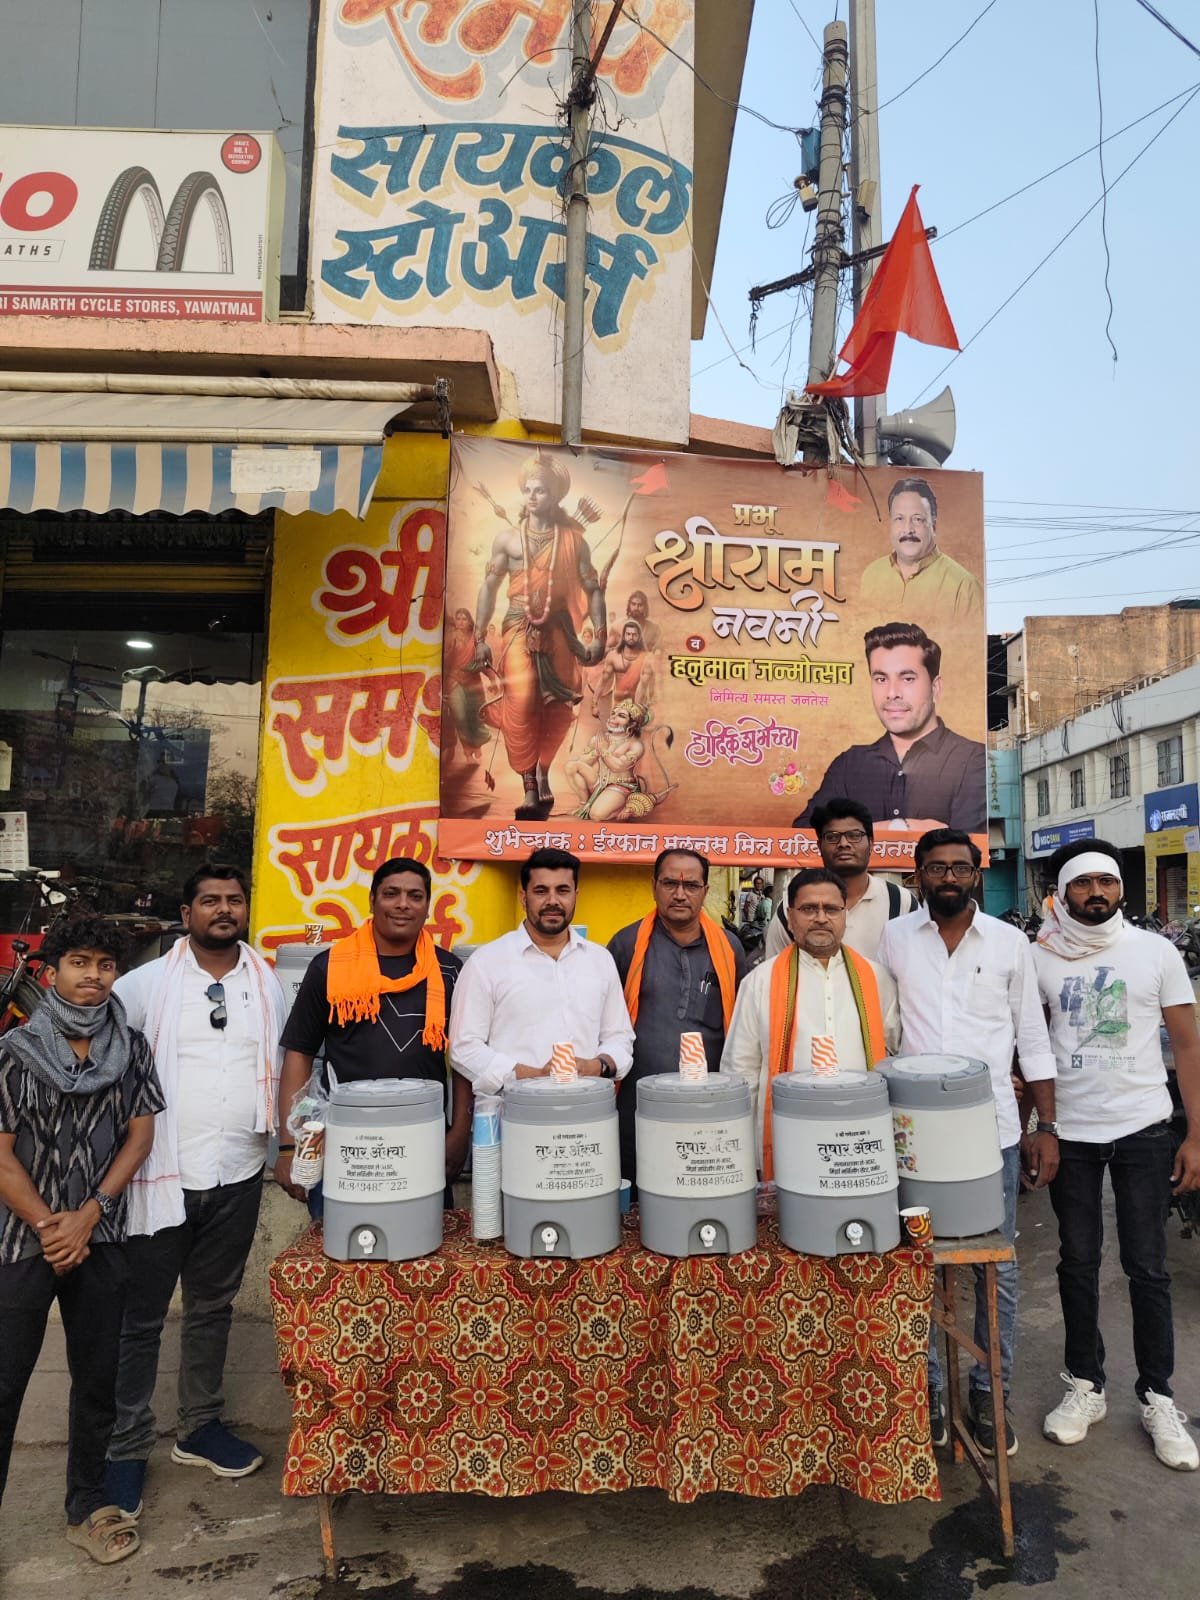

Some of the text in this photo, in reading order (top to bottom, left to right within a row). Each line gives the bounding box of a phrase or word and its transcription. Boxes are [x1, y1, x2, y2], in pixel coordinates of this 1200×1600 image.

[12, 296, 76, 311] SAMARTH
[80, 298, 121, 313] CYCLE
[126, 299, 180, 315] STORES,
[184, 301, 256, 316] YAWATMAL
[669, 653, 854, 687] हनुमान जन्मोत्सव
[753, 692, 787, 706] समस्त
[791, 690, 830, 706] जनतेस
